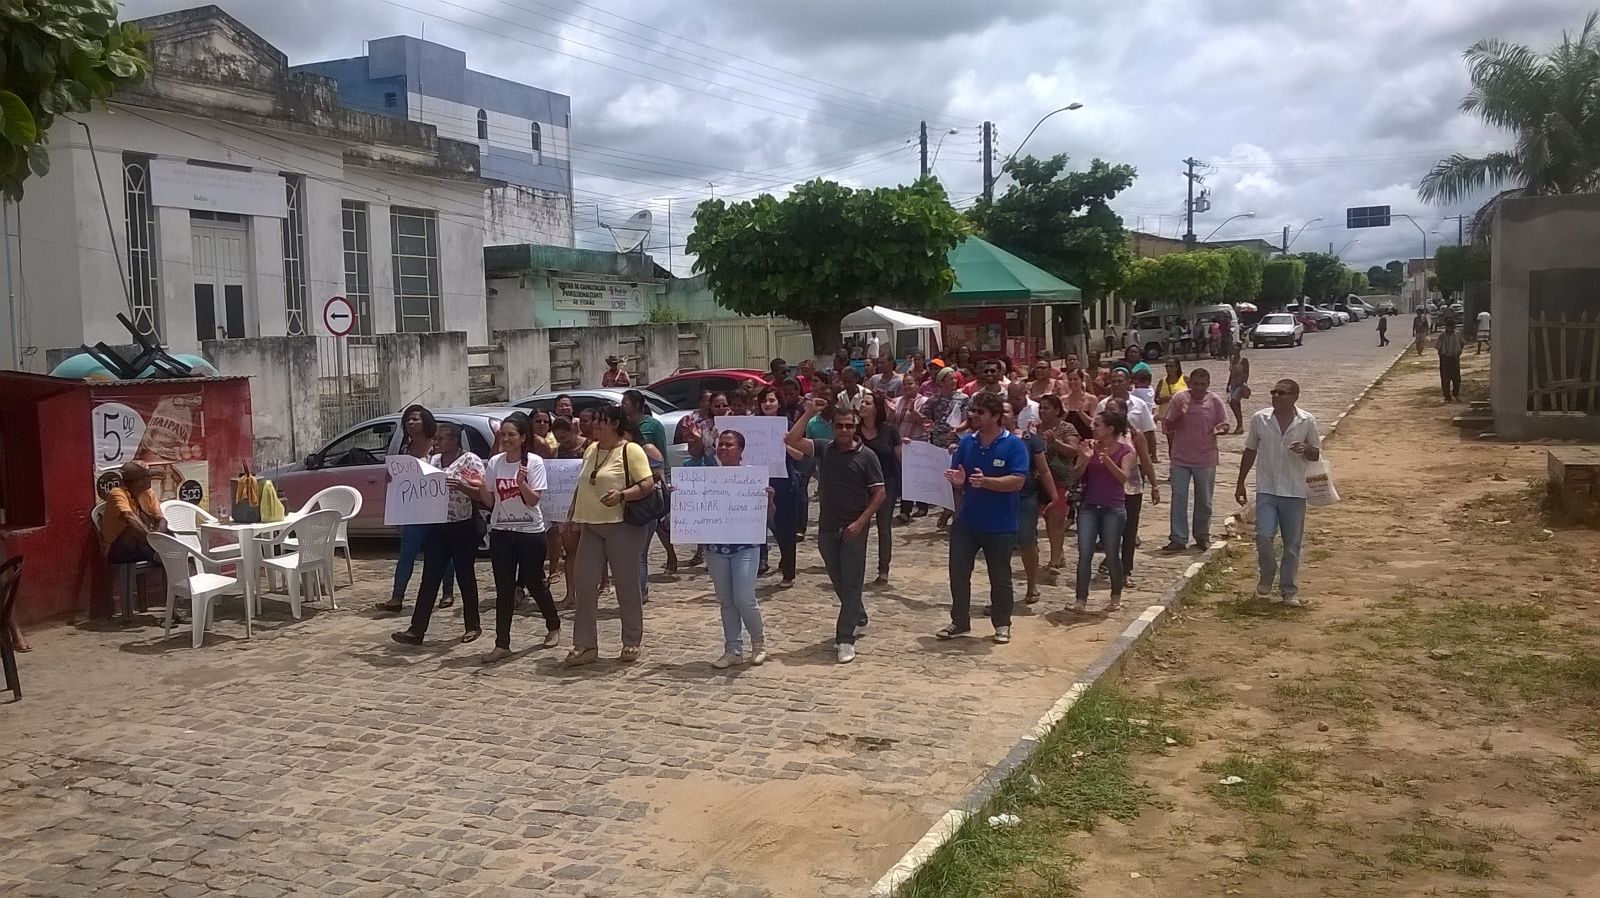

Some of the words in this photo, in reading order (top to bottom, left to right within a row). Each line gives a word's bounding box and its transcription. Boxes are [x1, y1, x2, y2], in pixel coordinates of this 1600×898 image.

[149, 416, 188, 443] ITAIPAVA
[722, 471, 764, 485] estudar
[181, 488, 201, 500] 5,00
[399, 478, 447, 504] PAROU
[674, 488, 698, 500] para
[672, 500, 720, 512] ENSINAR
[726, 503, 749, 515] para
